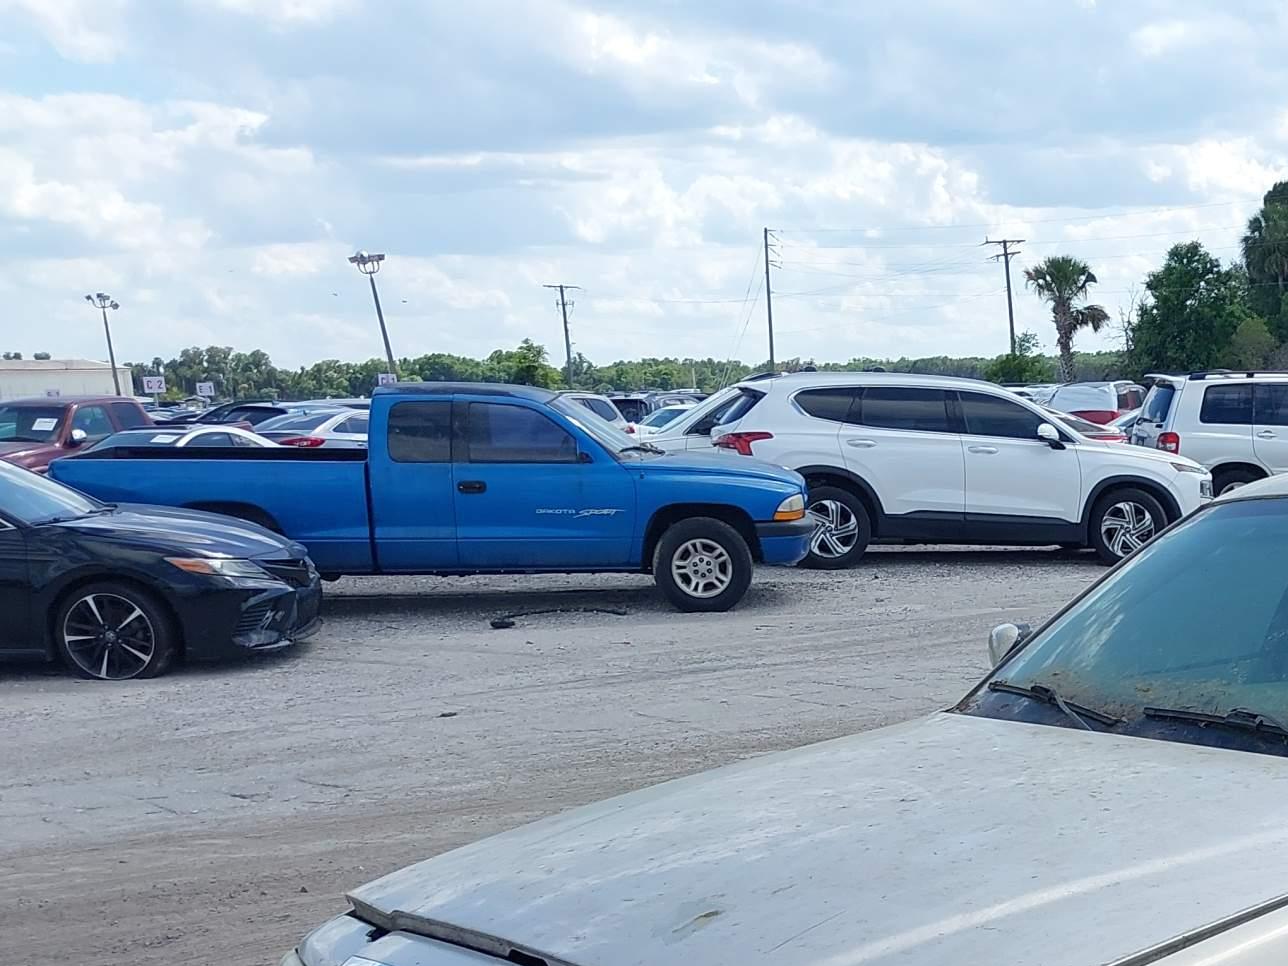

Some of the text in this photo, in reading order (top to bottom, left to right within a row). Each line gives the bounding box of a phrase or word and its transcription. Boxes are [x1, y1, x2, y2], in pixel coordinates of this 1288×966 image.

[146, 380, 164, 390] C 2
[573, 507, 626, 519] SPORT
